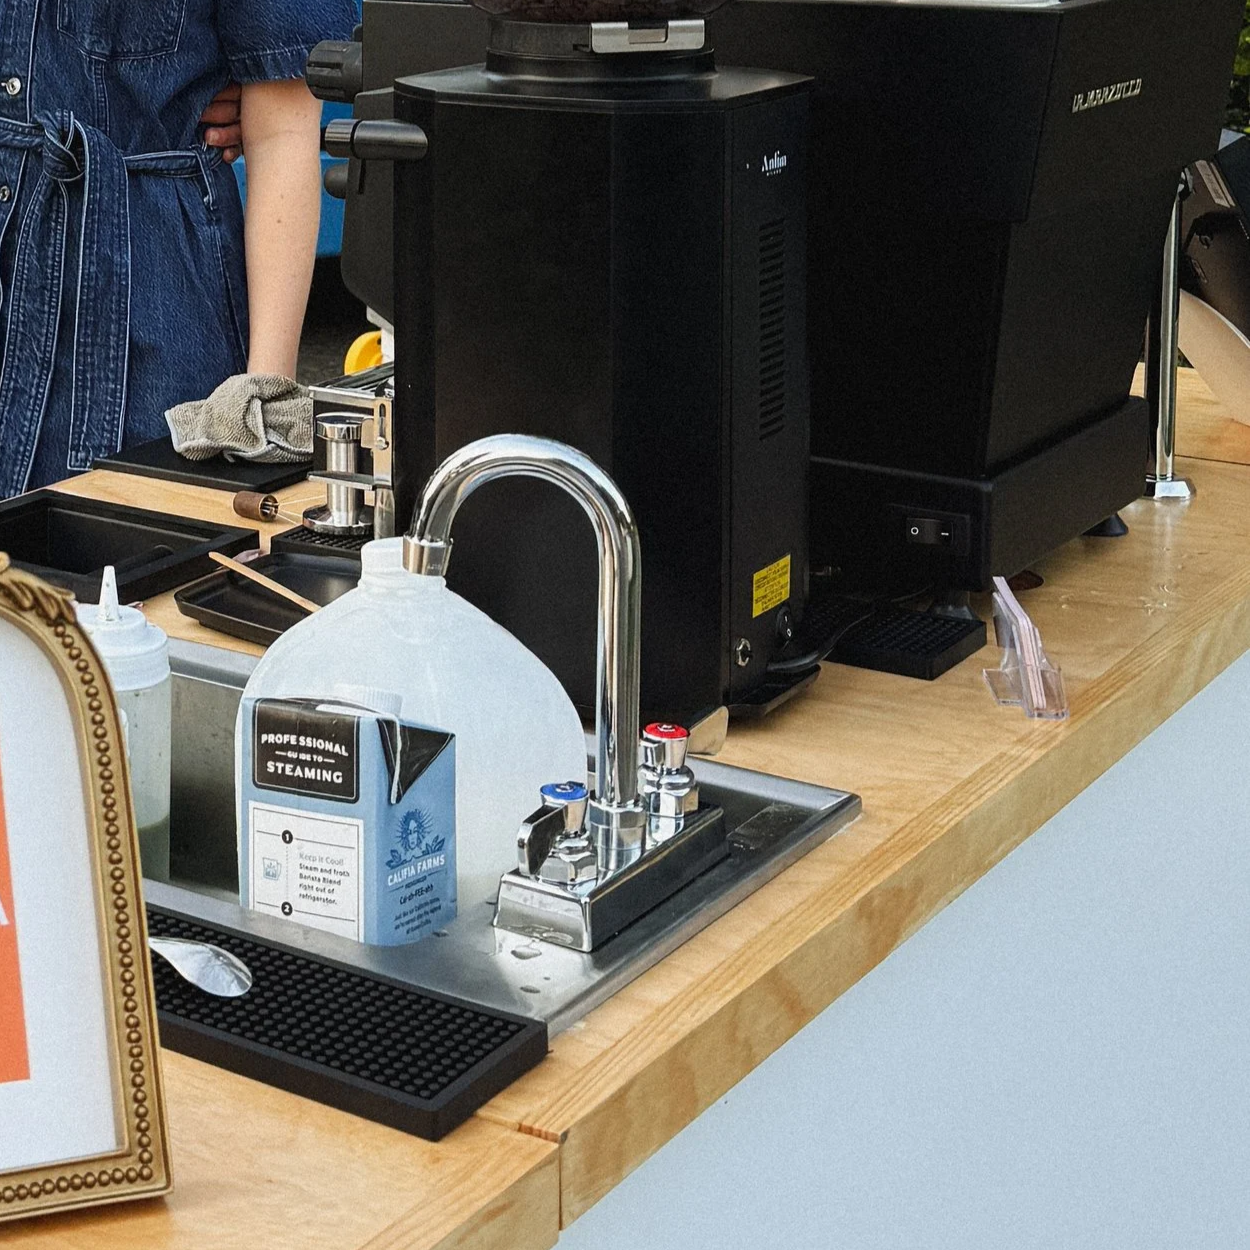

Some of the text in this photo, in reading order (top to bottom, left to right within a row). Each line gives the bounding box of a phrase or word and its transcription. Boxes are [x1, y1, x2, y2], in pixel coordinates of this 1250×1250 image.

[261, 733, 349, 756] PROFESSIONAL
[313, 754, 323, 762] TO
[266, 760, 343, 784] STEAMING
[320, 866, 332, 874] and
[387, 865, 416, 886] CALIFIA
[417, 854, 445, 874] FARMS
